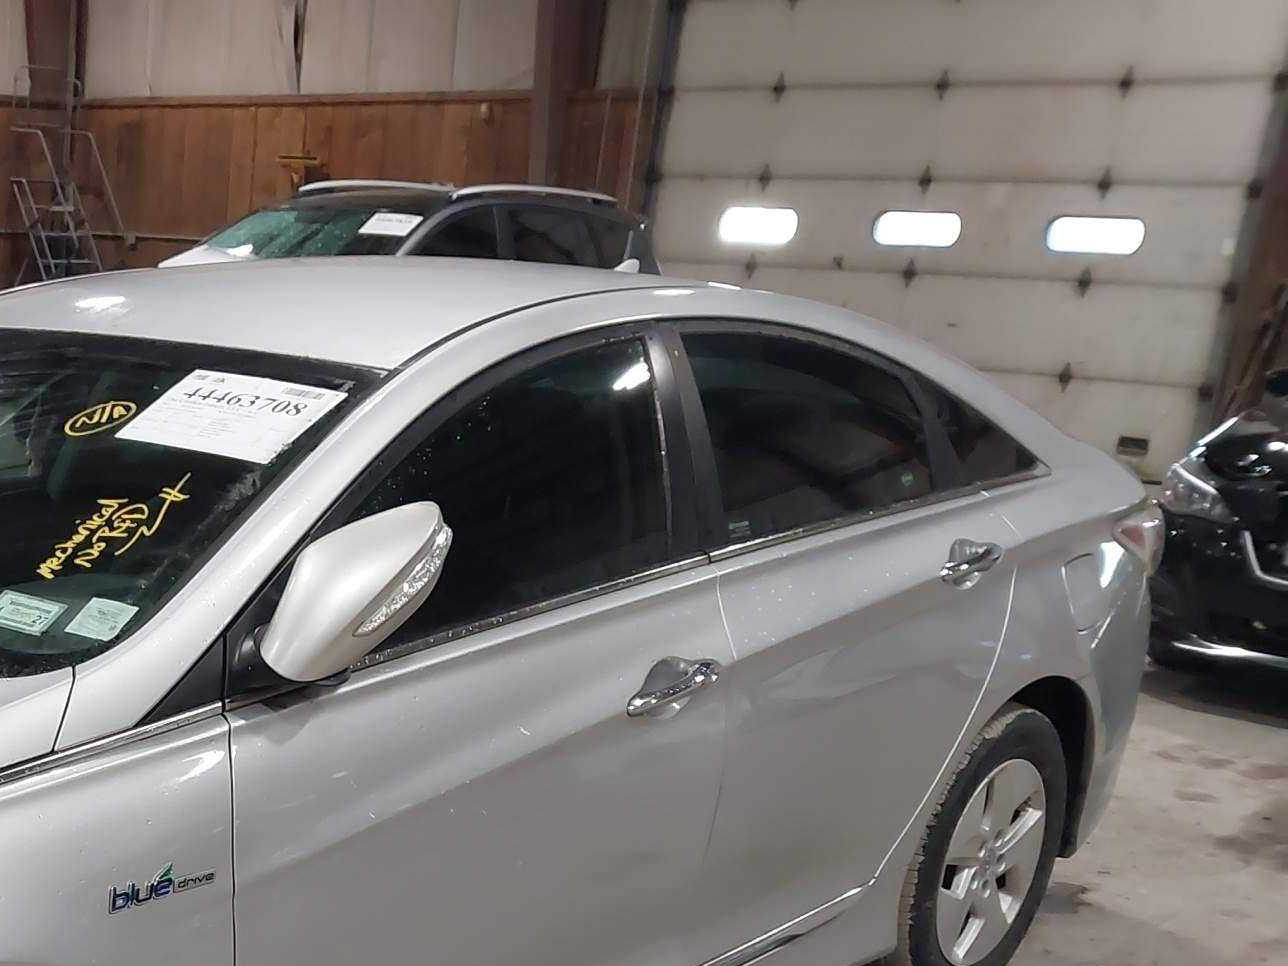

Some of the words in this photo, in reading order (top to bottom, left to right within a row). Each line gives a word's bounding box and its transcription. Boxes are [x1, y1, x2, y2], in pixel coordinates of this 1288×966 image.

[74, 401, 128, 428] N/A
[183, 386, 308, 417] 44463708
[73, 541, 107, 568] No
[108, 868, 173, 914] blue
[177, 872, 215, 890] drive
